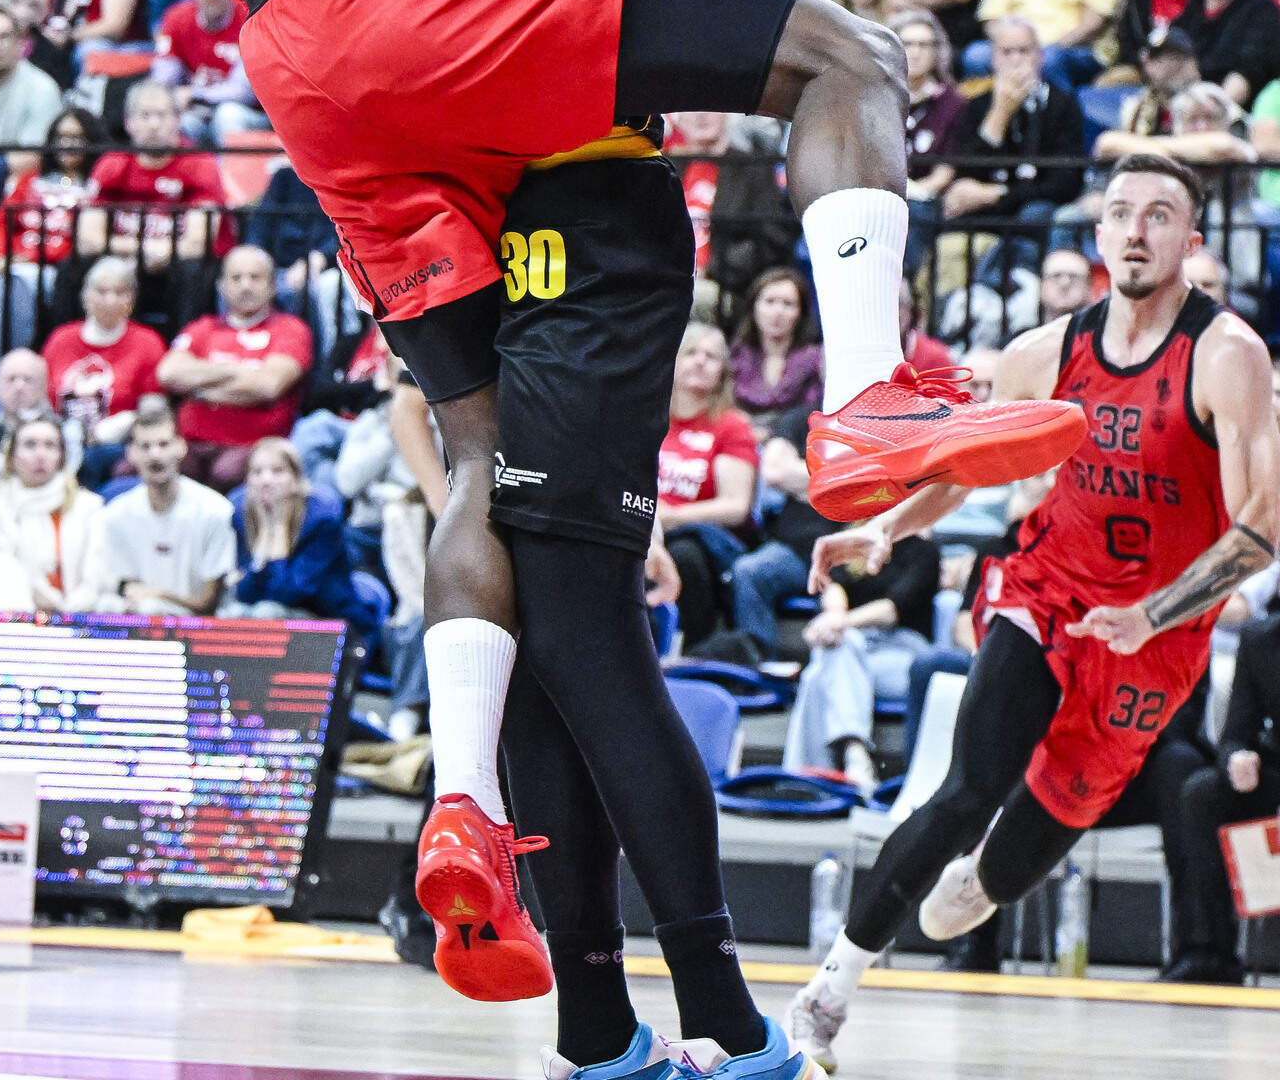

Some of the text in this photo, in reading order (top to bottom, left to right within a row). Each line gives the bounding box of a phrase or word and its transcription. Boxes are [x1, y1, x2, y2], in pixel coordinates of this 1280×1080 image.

[500, 228, 567, 304] 30
[1092, 403, 1143, 454] 32
[622, 491, 655, 515] RAES
[1109, 683, 1167, 733] 32
